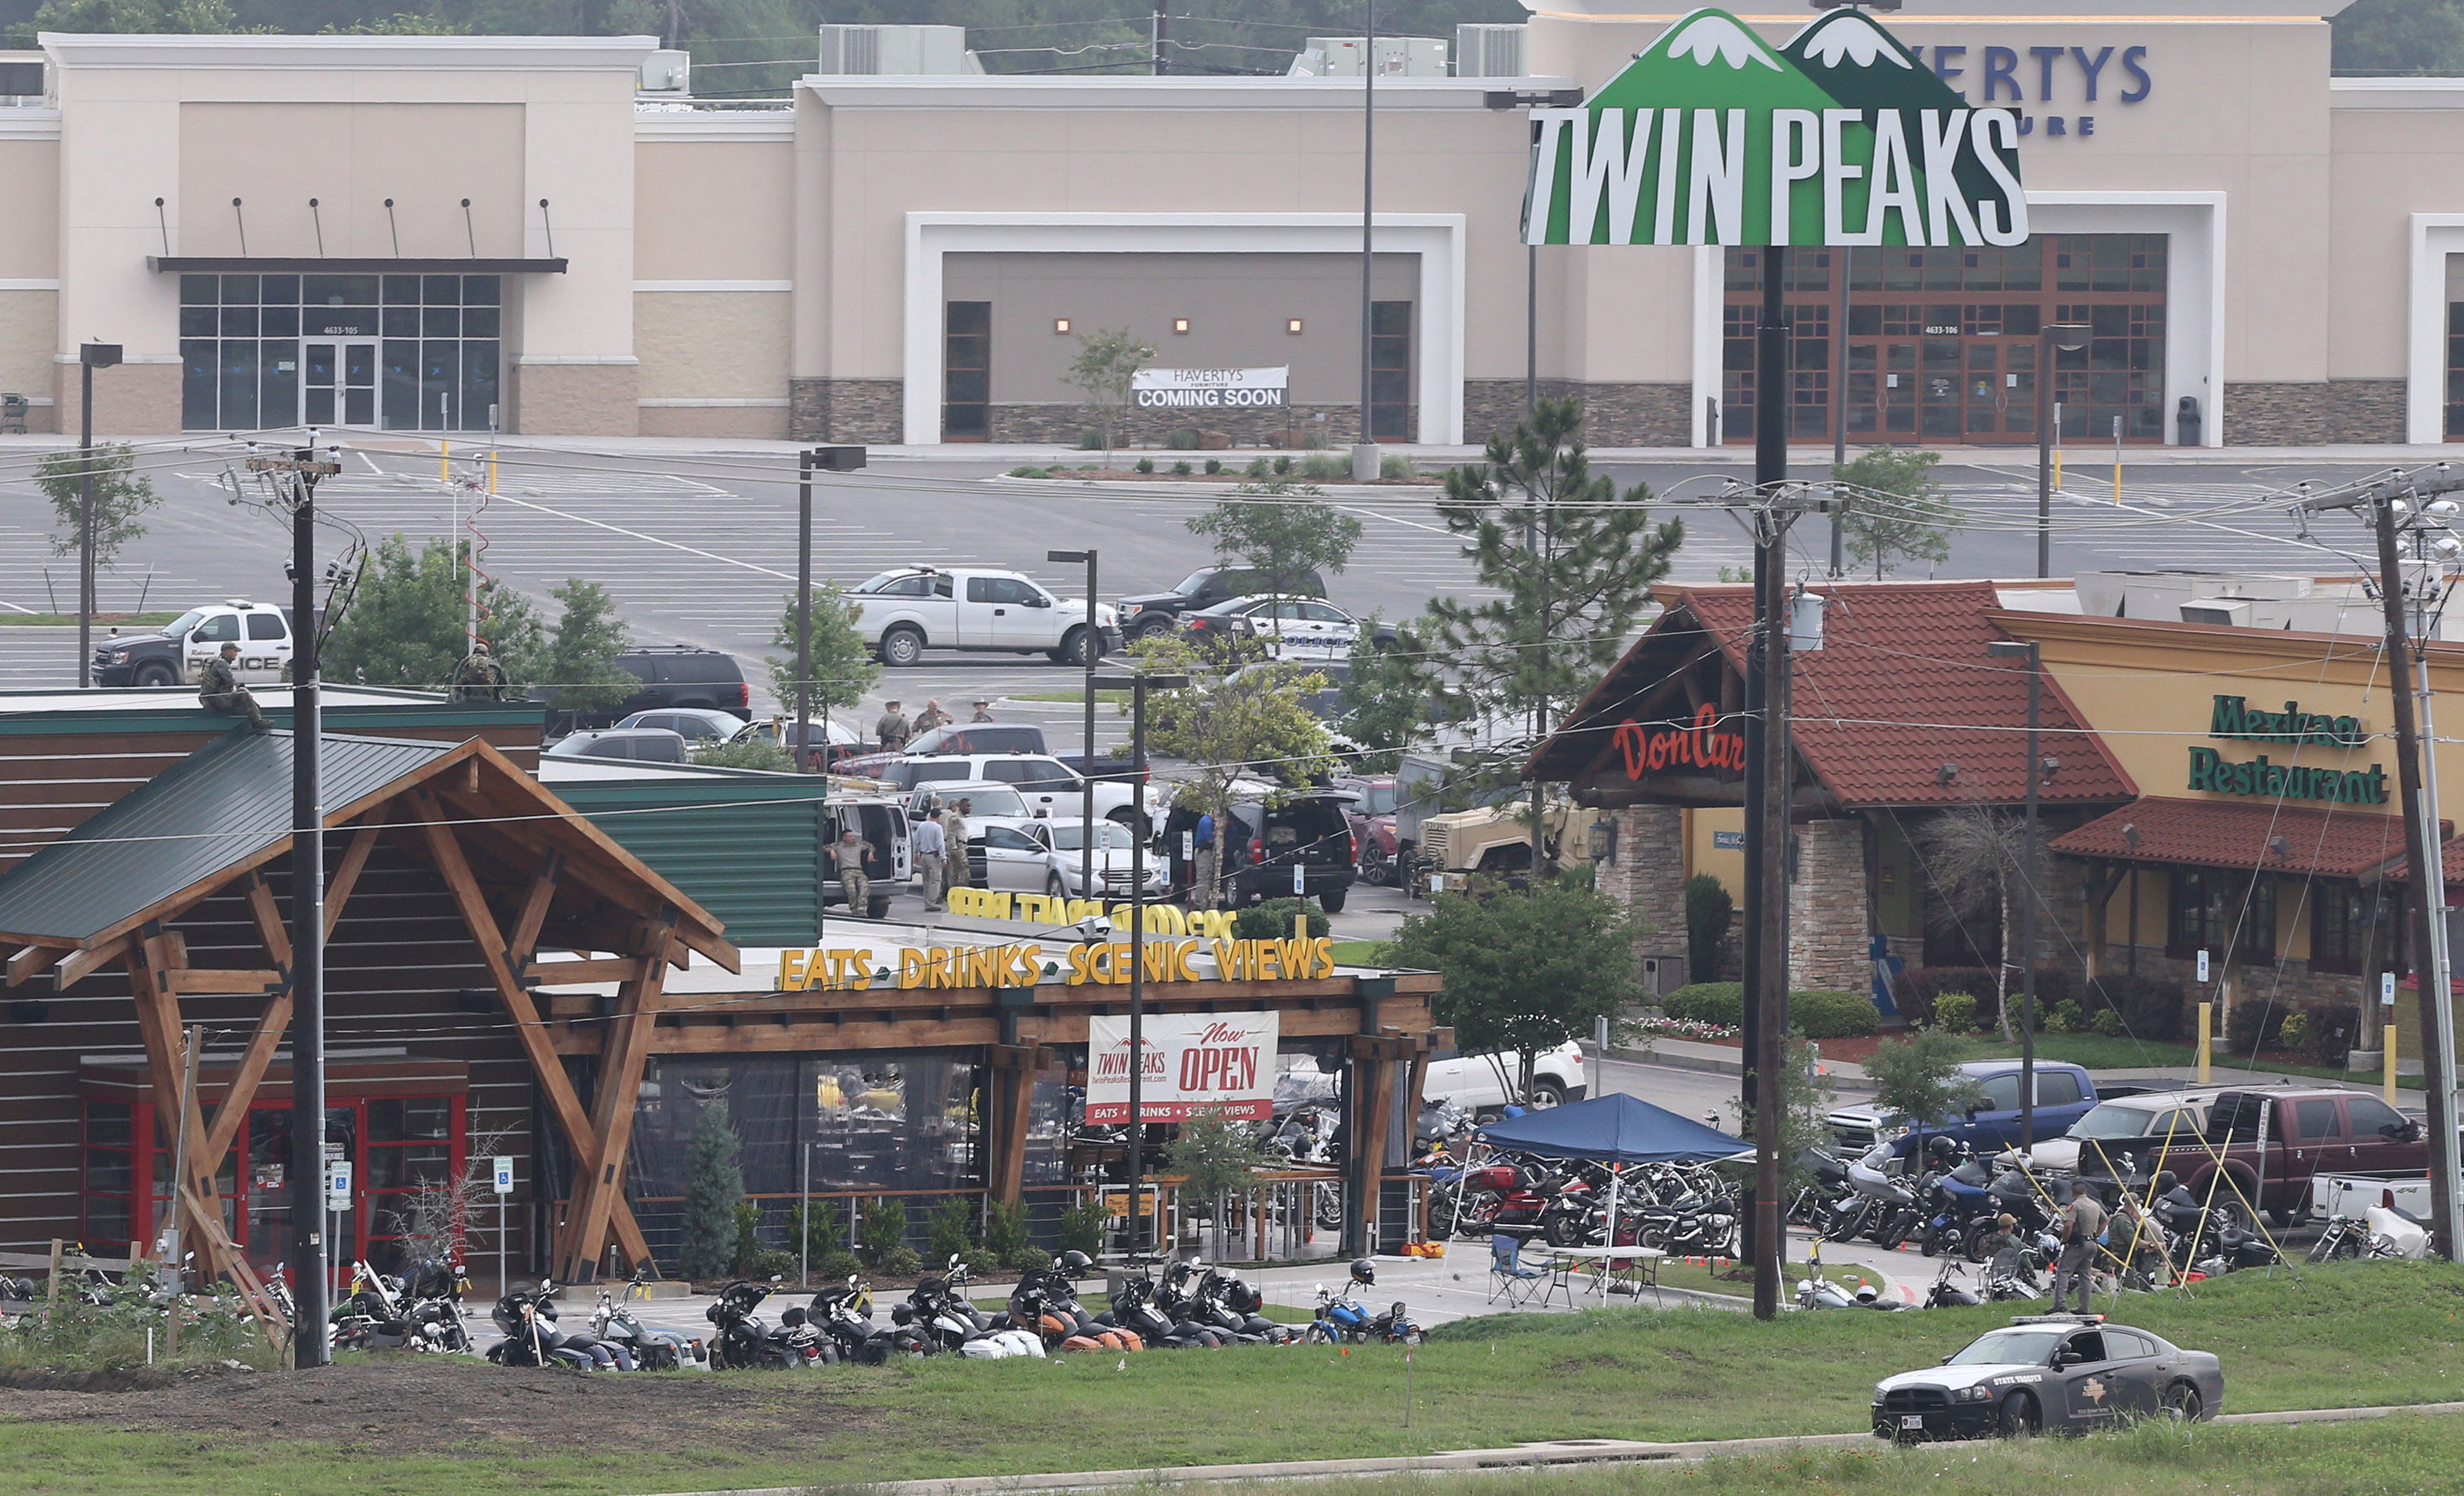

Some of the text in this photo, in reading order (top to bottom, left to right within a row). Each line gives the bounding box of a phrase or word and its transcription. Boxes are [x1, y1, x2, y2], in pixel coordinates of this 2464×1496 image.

[1911, 45, 2152, 102] ERTYS
[1527, 107, 2029, 247] TWIN PEAKS
[324, 326, 358, 335] 4633-105
[1174, 369, 1244, 382] HAVERTYS
[1138, 389, 1281, 407] COMING SOON
[1282, 636, 1347, 648] OLICE
[186, 657, 280, 671] PICE
[2209, 694, 2366, 748] Mexican
[1613, 703, 1746, 780] Don Car
[2188, 745, 2388, 804] Restaurant
[779, 937, 1334, 991] EATS DRINKS SCENIC VIEWS
[1200, 1022, 1245, 1045] Now
[1098, 1052, 1165, 1075] TWIN EAKS
[1179, 1047, 1259, 1091] OPEN
[1094, 1108, 1118, 1118] EATS
[1139, 1107, 1171, 1117] RINKS
[1224, 1105, 1255, 1115] VIEWS
[1993, 1373, 2043, 1386] STATE TROOPER
